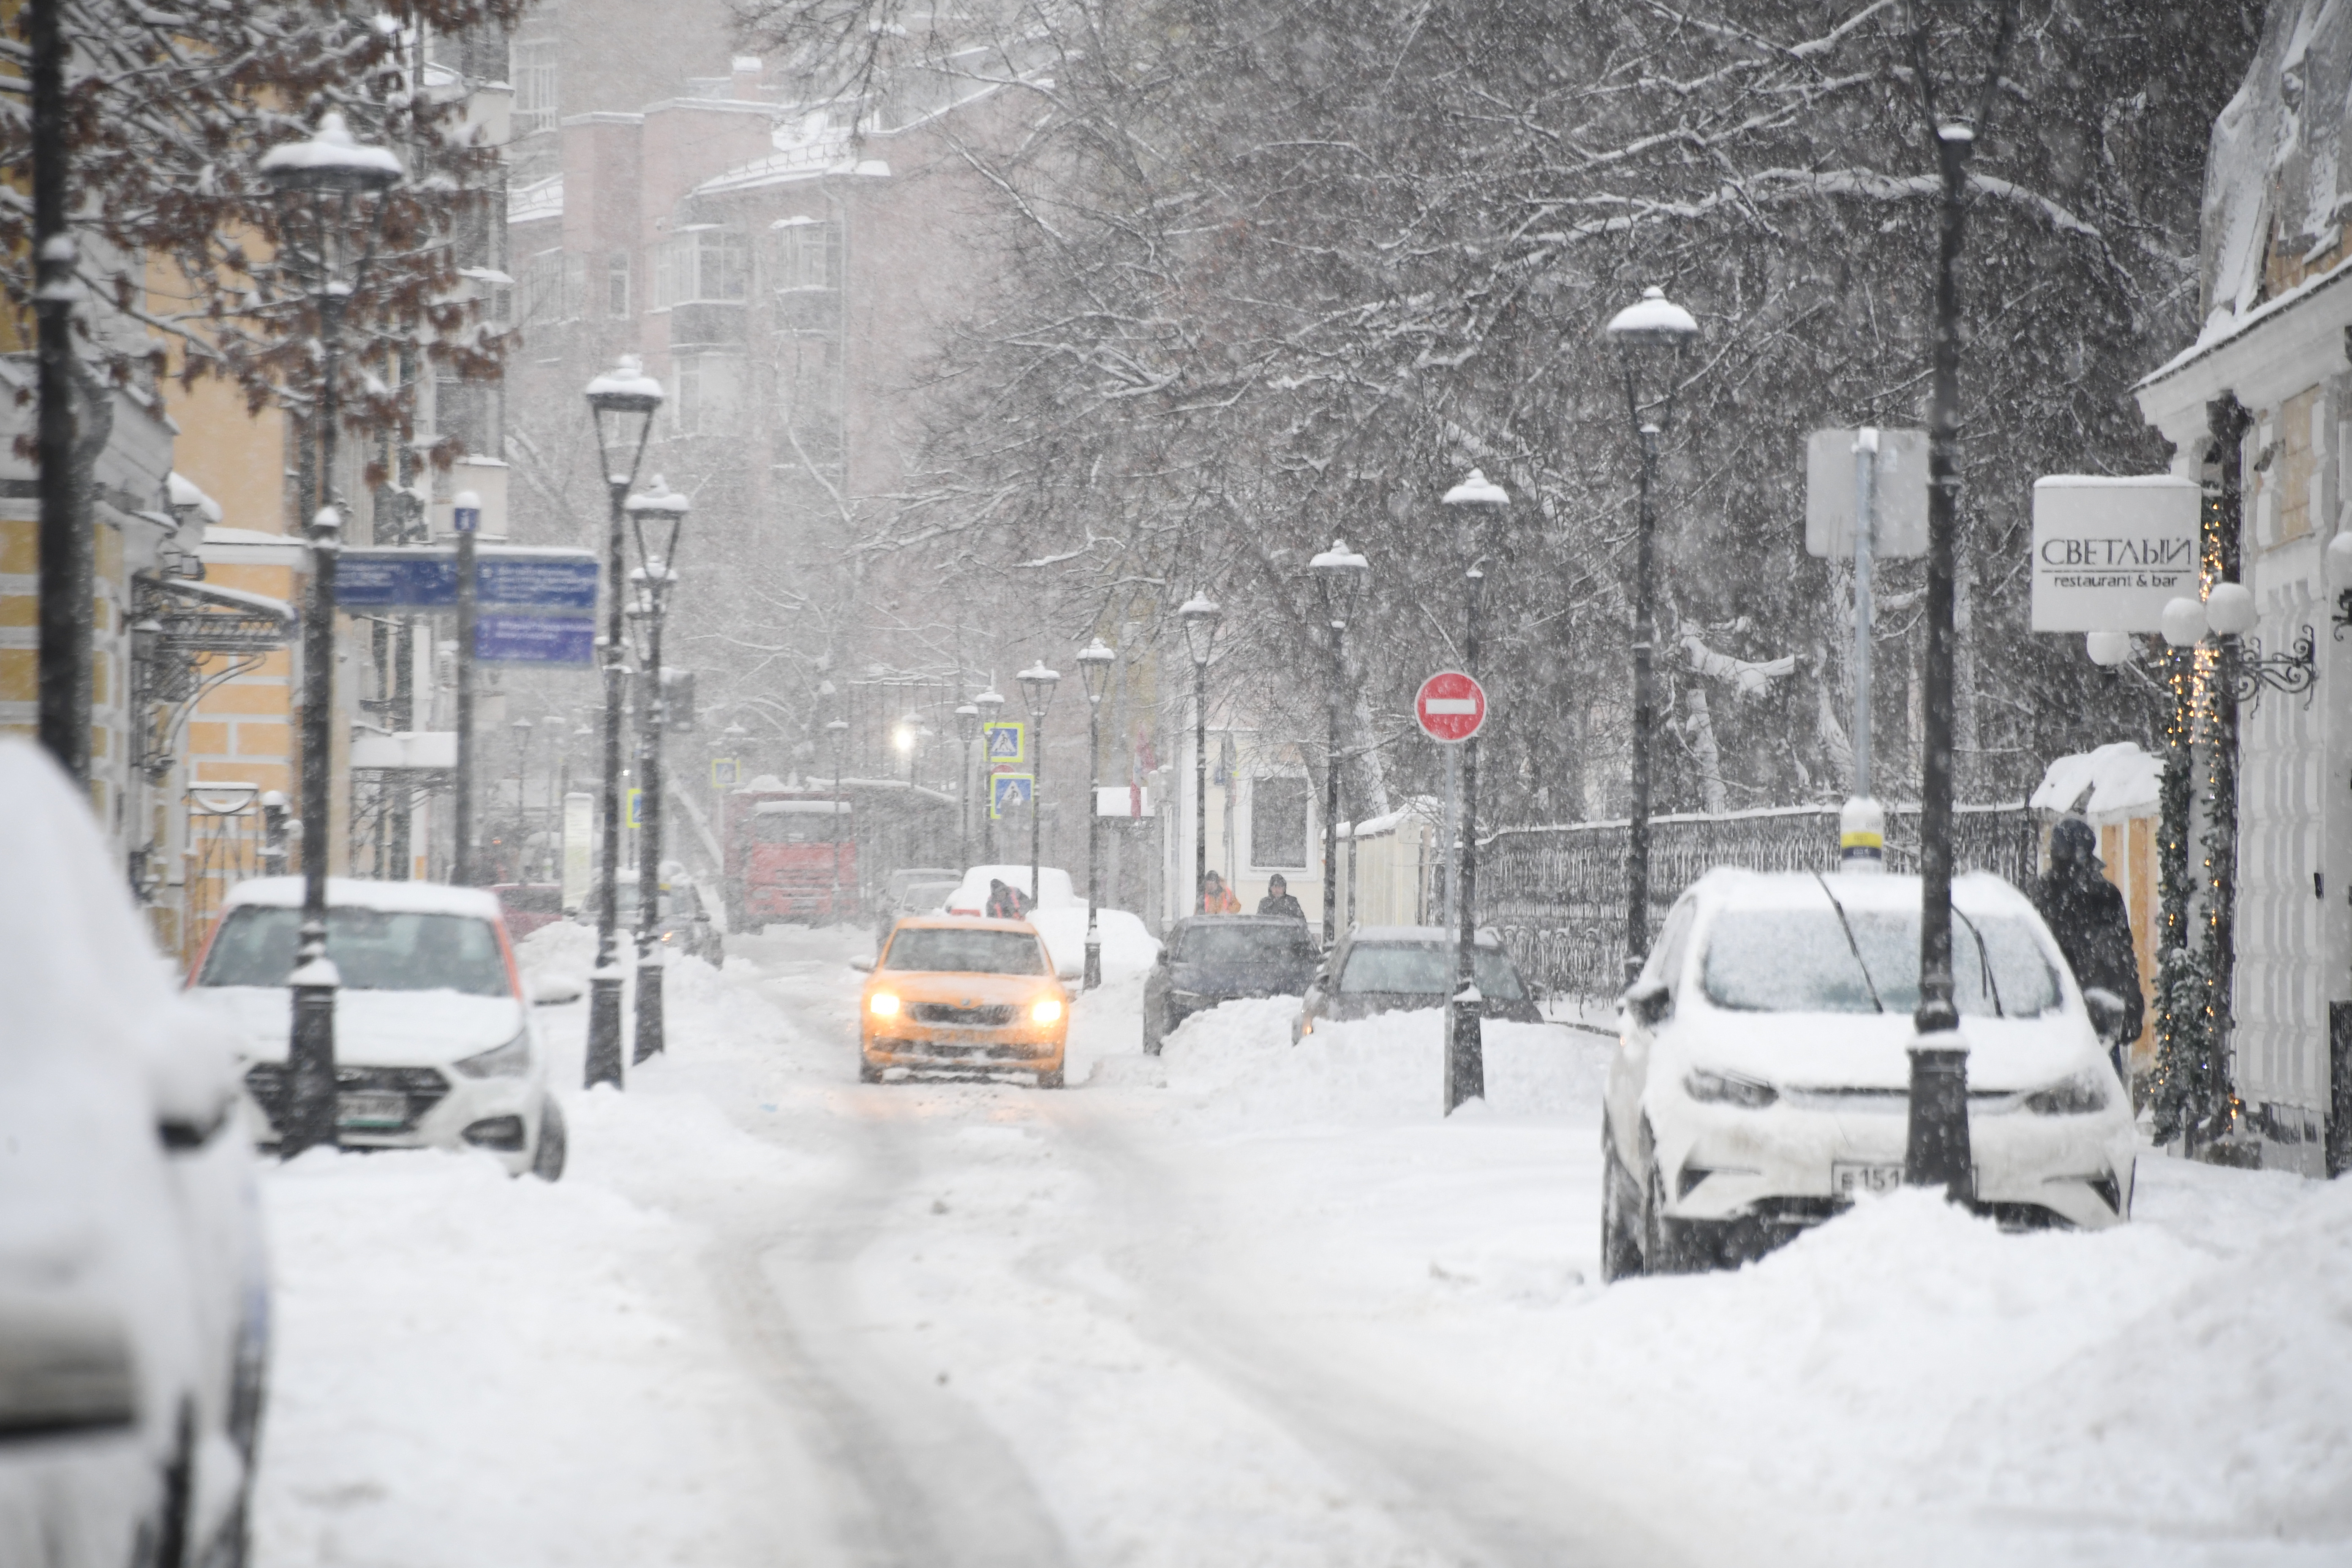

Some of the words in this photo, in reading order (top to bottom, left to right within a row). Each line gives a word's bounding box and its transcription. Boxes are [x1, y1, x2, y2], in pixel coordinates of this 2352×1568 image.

[2042, 537, 2191, 565] СВЕТЛЫЙ
[2054, 575, 2132, 587] restaurant
[2137, 574, 2148, 587] &
[2152, 574, 2178, 587] bar
